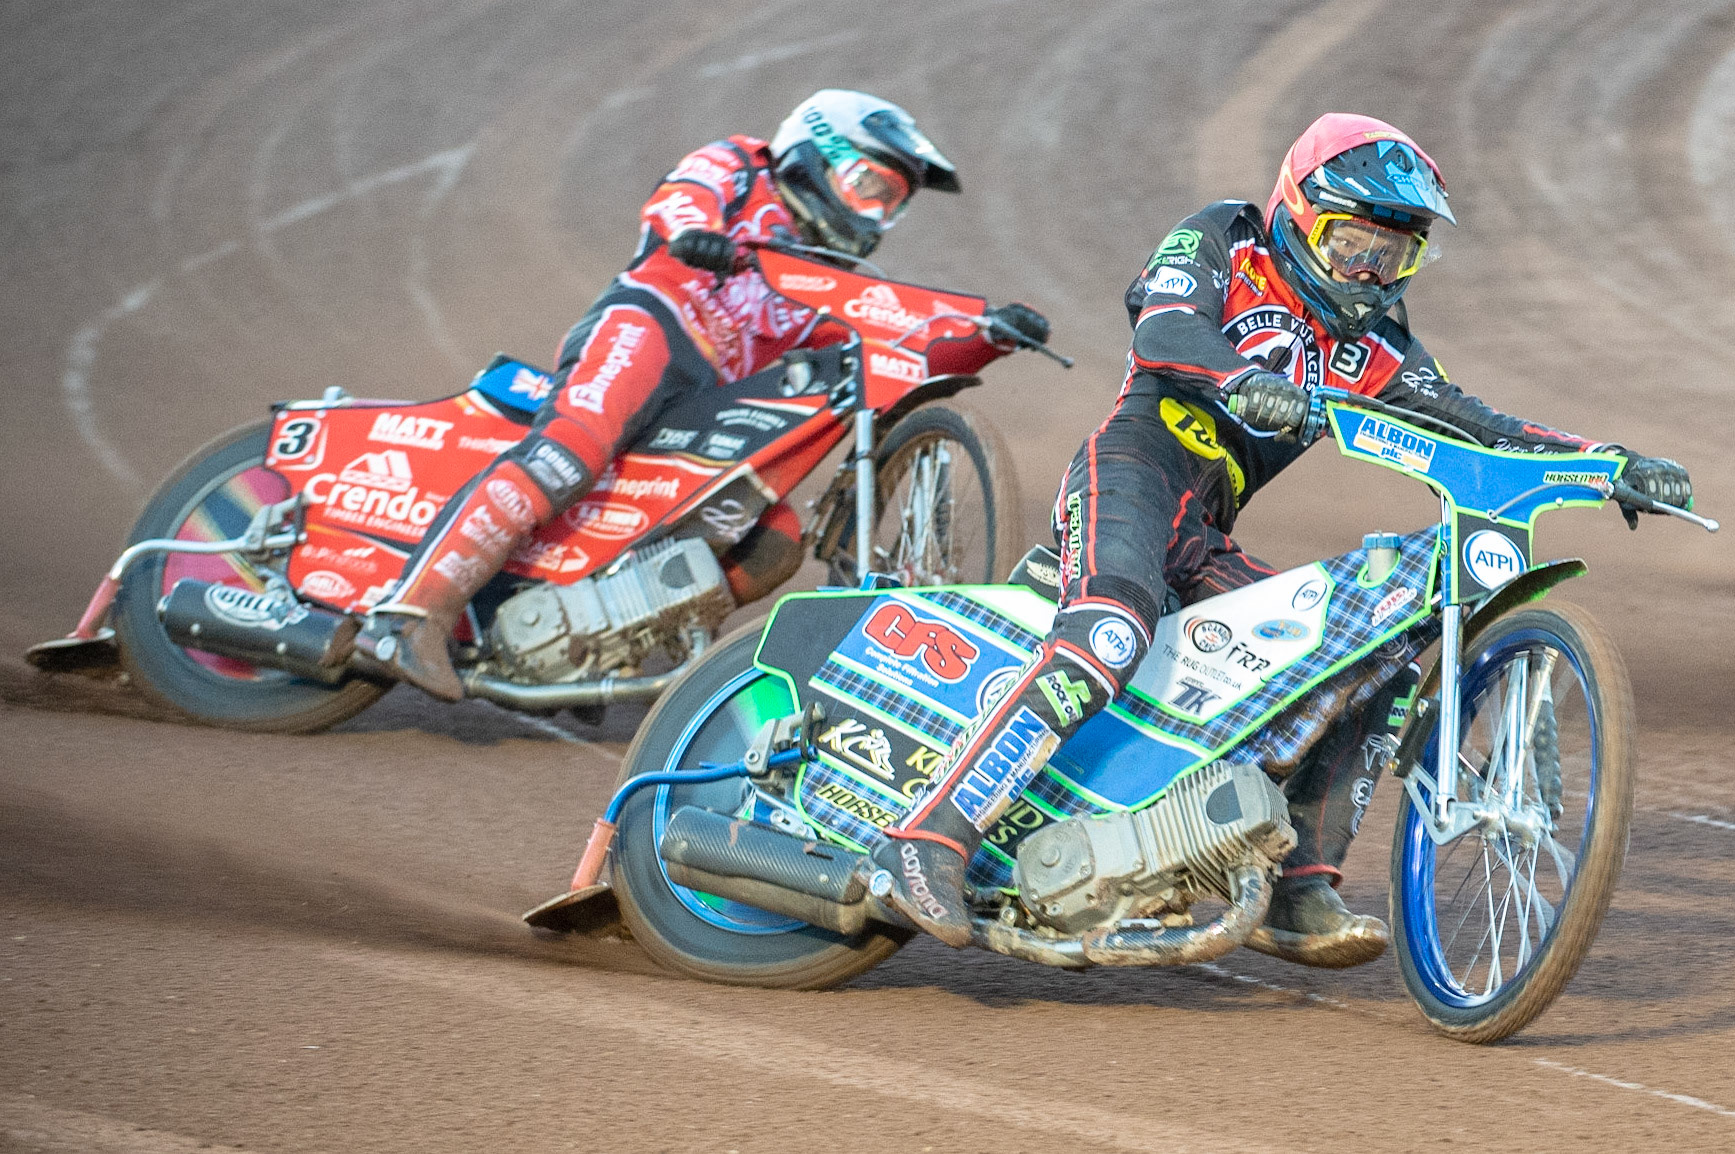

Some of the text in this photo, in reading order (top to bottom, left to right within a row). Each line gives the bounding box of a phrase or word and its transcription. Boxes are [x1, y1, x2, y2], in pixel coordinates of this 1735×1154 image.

[1236, 313, 1318, 392] BELLE VUE ACES
[1335, 342, 1362, 374] 3
[277, 420, 316, 456] 3
[369, 412, 454, 442] MATT
[1361, 417, 1434, 457] ALBON
[1381, 447, 1403, 460] plc
[1475, 548, 1514, 573] ATPI
[1100, 627, 1127, 658] ATPI
[1162, 643, 1180, 662] THE
[1181, 654, 1200, 671] RUG
[1047, 675, 1070, 708] ROCK
[954, 709, 1046, 821] ALBON
